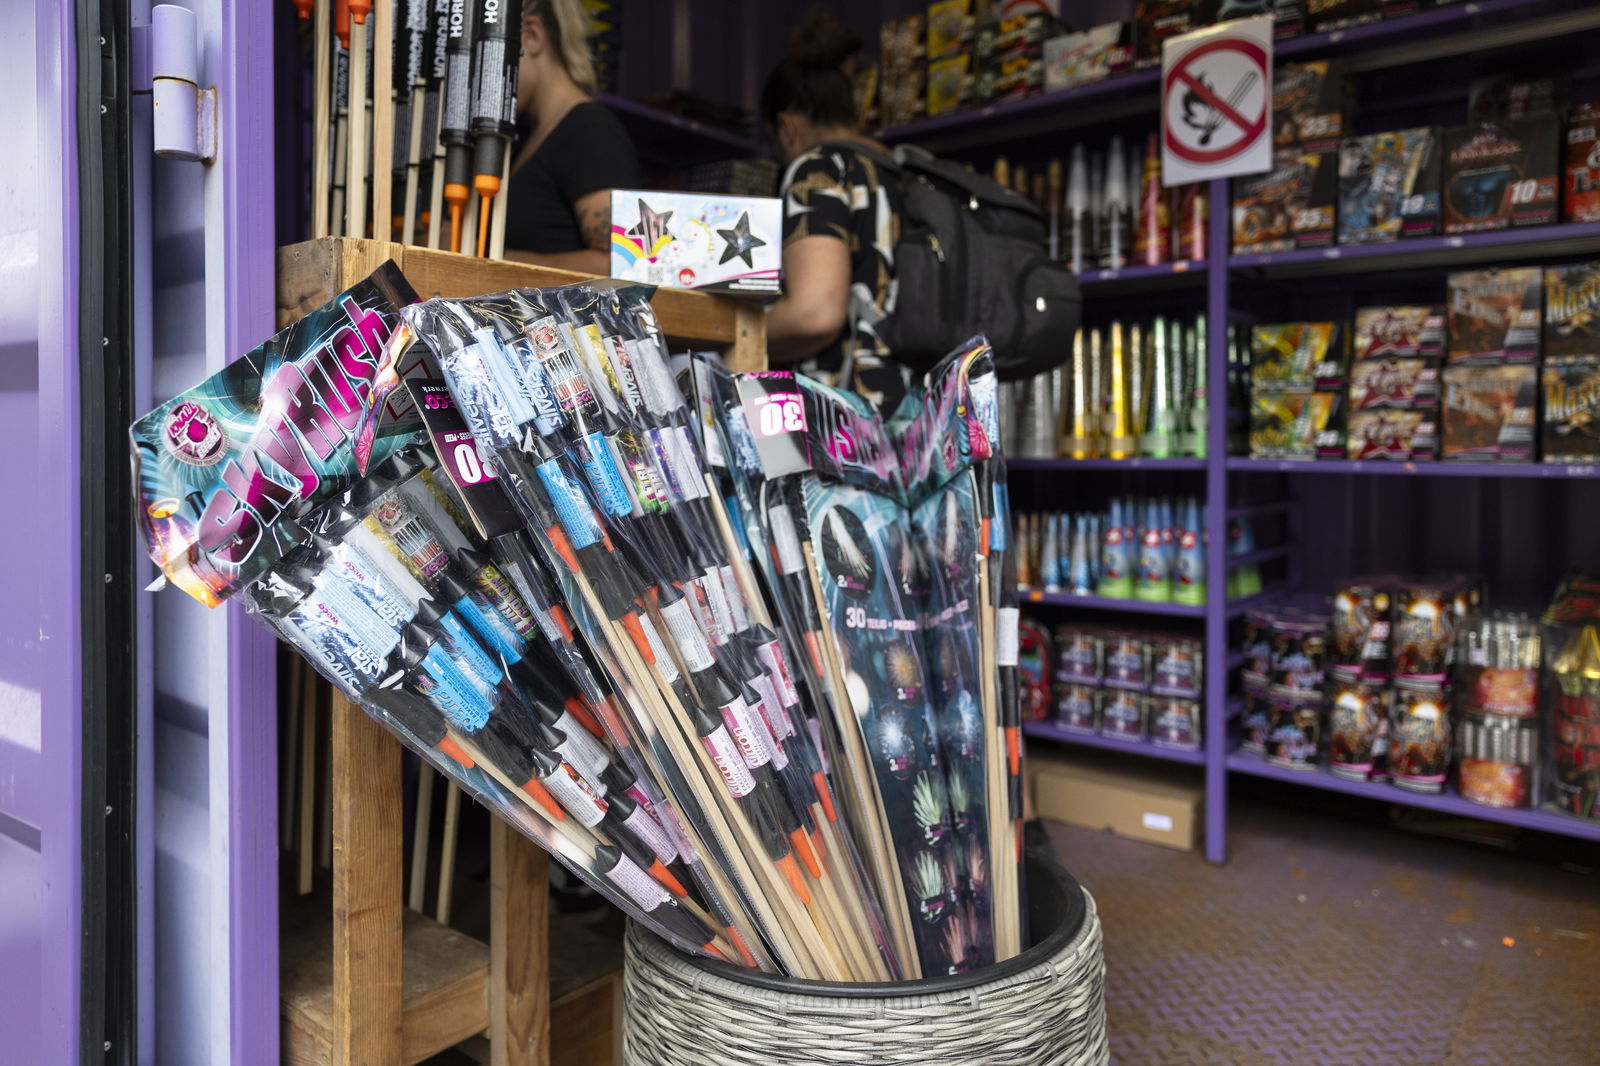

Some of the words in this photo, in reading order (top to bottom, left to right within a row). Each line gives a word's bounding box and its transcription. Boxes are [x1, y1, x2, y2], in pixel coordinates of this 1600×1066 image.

[1510, 179, 1537, 204] 10
[760, 401, 804, 436] 30
[368, 596, 404, 630] star
[845, 605, 866, 628] 30
[339, 641, 379, 679] star
